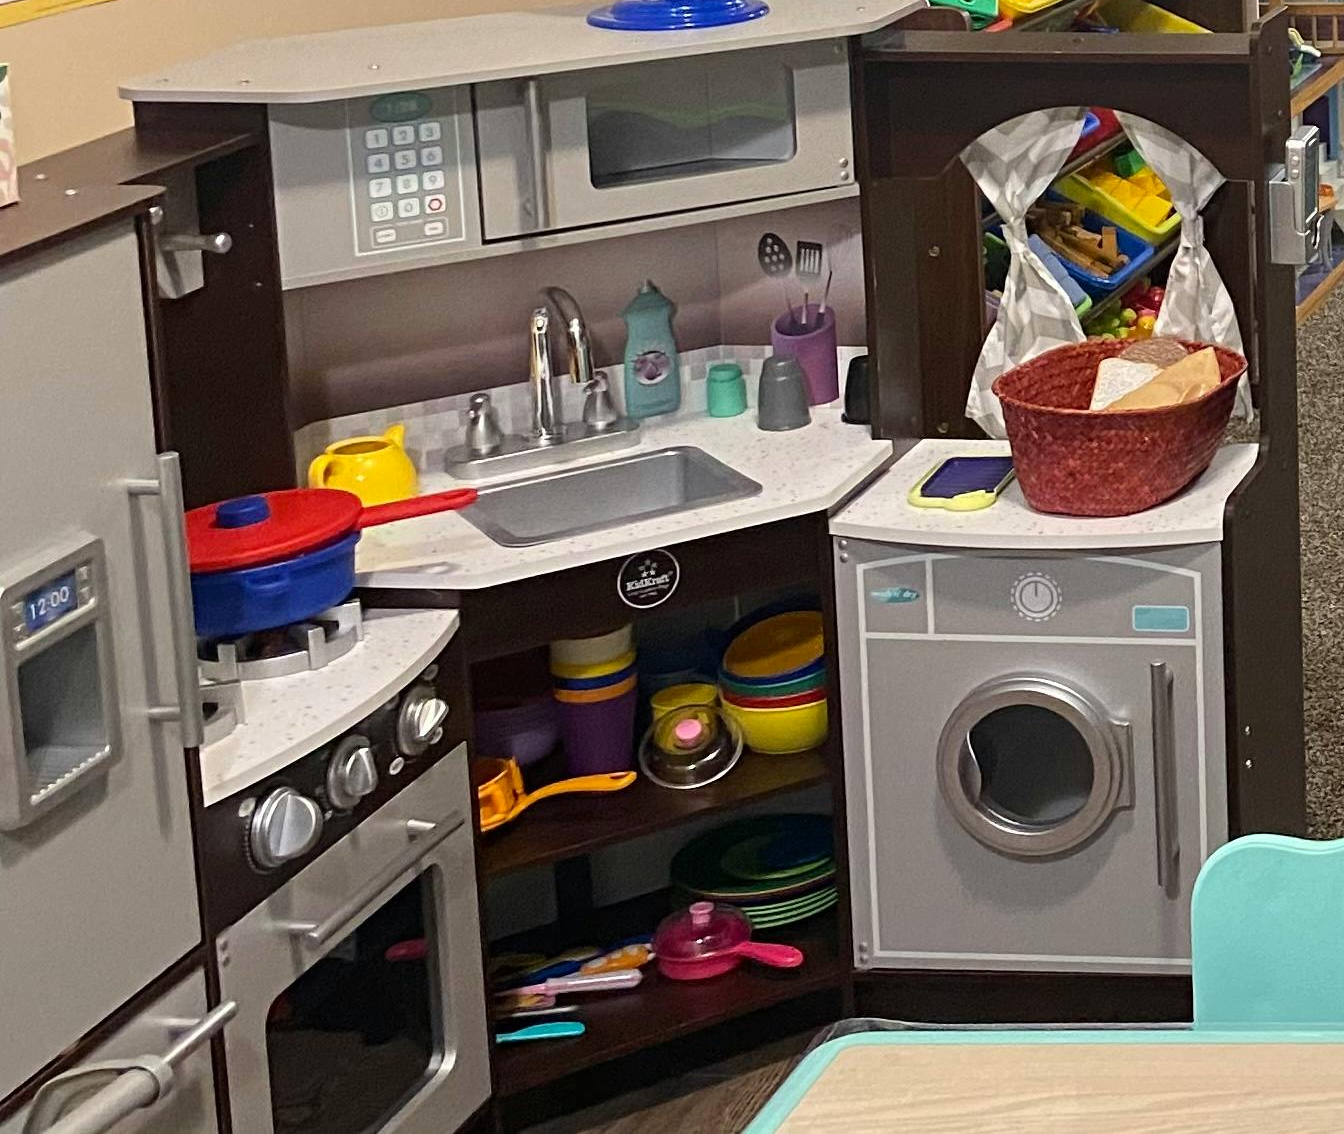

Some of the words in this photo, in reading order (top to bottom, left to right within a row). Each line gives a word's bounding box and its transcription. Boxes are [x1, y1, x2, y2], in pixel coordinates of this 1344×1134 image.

[374, 133, 380, 143] 1
[399, 129, 408, 142] 2
[425, 126, 434, 138] 3
[373, 157, 383, 169] 4
[401, 153, 410, 166] 5
[427, 151, 436, 163] 6
[375, 182, 385, 194] 7
[402, 178, 411, 190] 8
[428, 174, 437, 188] 9
[404, 201, 413, 213] 0
[30, 586, 70, 621] 12:00
